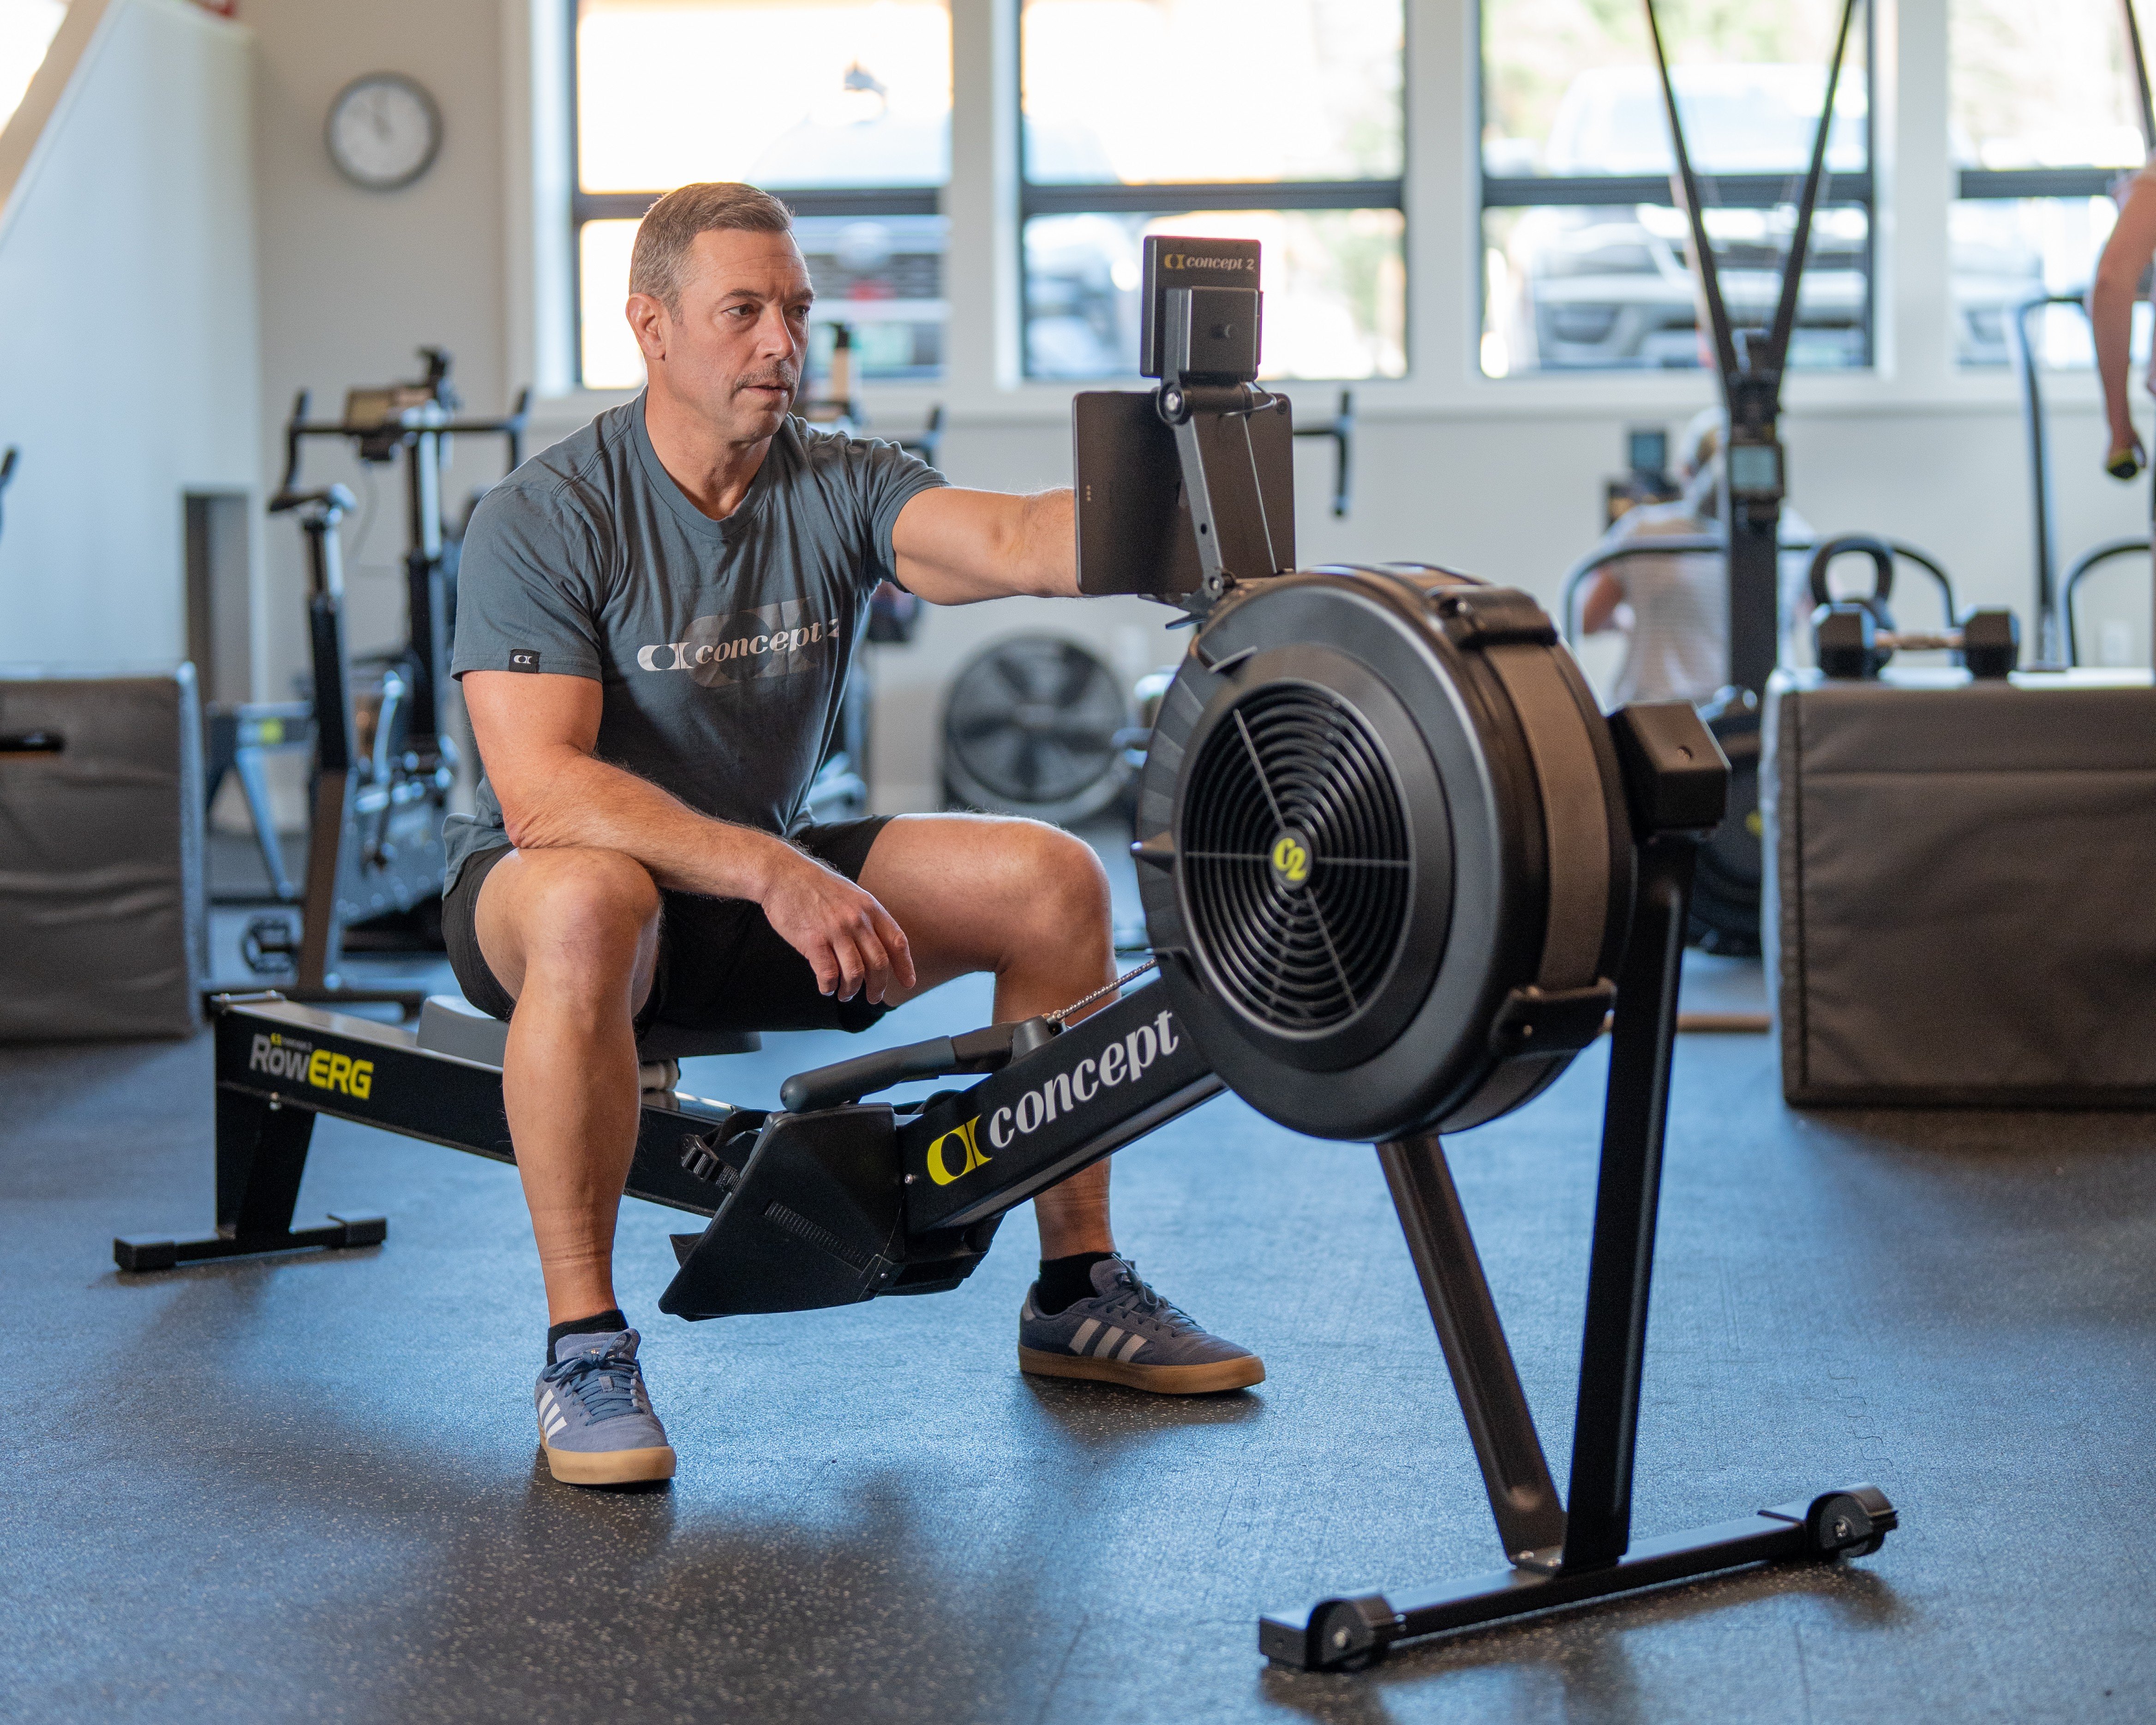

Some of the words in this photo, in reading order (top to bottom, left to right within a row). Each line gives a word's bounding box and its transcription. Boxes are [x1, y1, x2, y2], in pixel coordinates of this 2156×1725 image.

[1186, 257, 1243, 270] concept
[1246, 258, 1255, 270] 2
[695, 622, 822, 664] concept
[1274, 836, 1307, 881] C2
[989, 1009, 1179, 1148] concept
